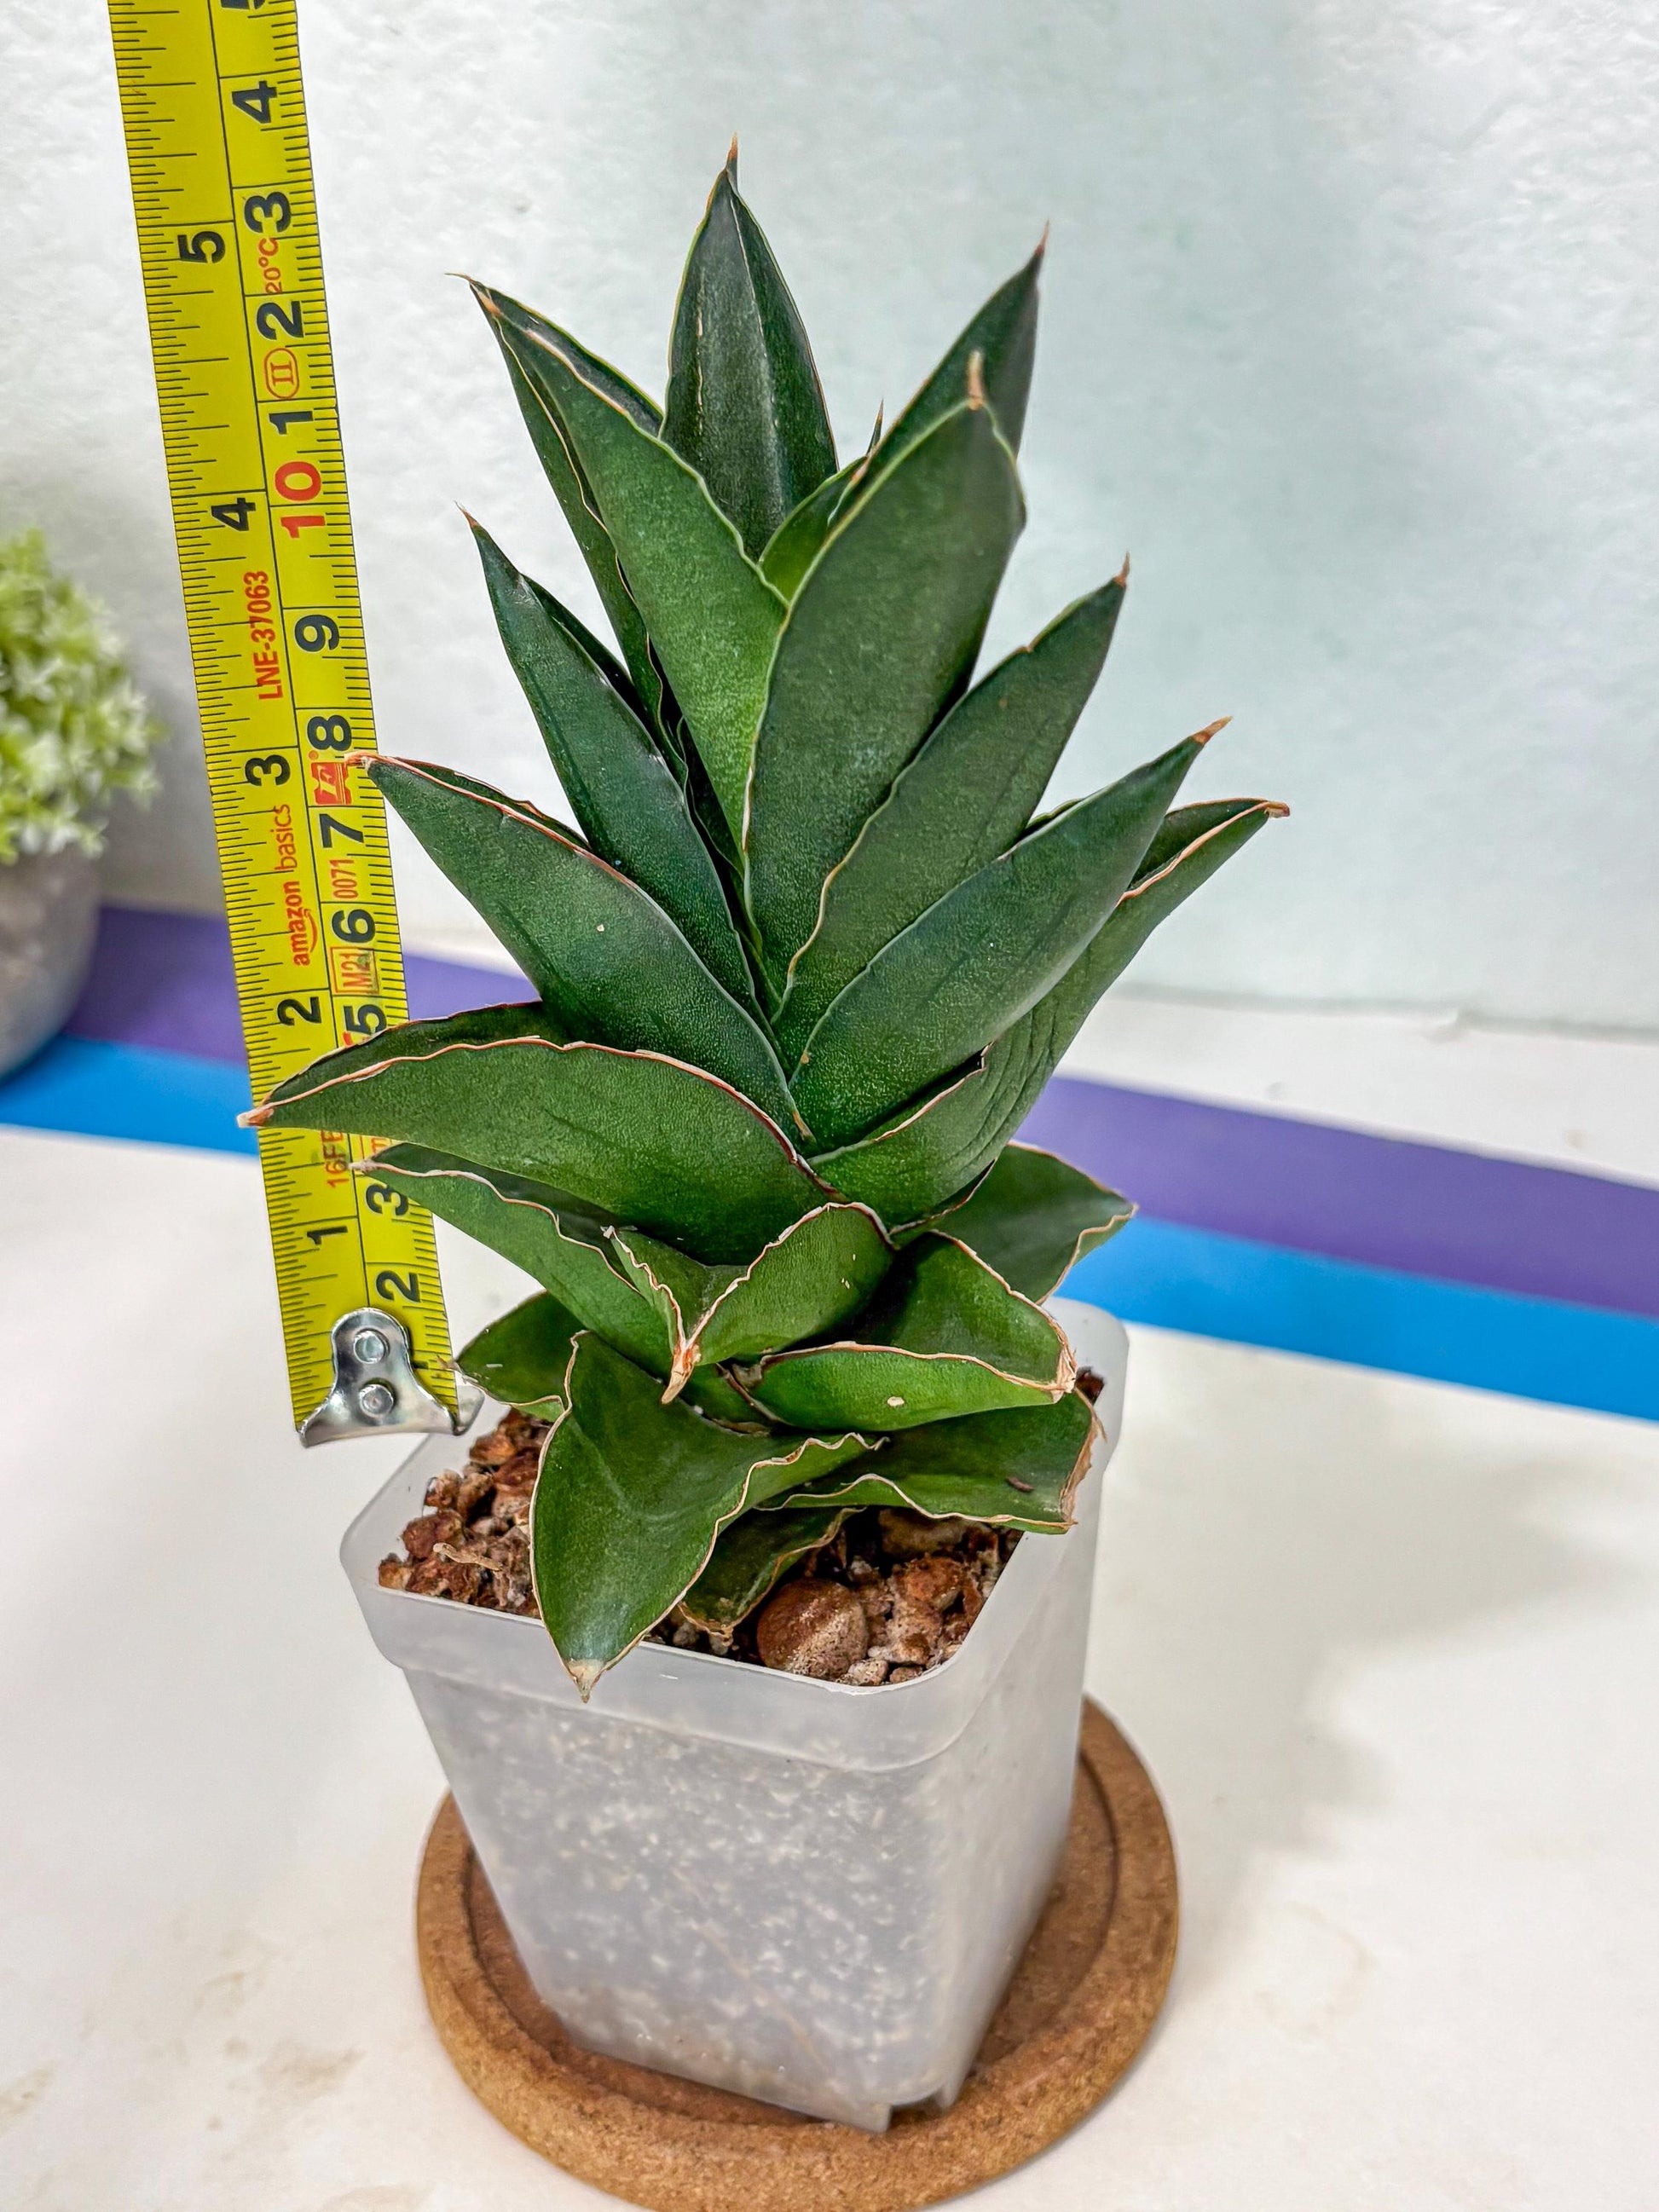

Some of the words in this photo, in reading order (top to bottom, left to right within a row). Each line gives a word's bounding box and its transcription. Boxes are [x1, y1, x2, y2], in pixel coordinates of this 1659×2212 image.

[232, 80, 277, 124] 4
[244, 191, 291, 233] 3
[177, 231, 226, 264] 5
[258, 238, 282, 294] 20°C
[256, 301, 304, 340] 2
[269, 411, 313, 435] 1
[211, 497, 256, 531] 4
[275, 461, 326, 538] 10
[244, 571, 283, 700] LNE-37063
[294, 615, 340, 651] 9
[308, 714, 352, 750] 8
[245, 754, 290, 786] 3
[271, 804, 298, 873] basics
[320, 813, 364, 848] 7
[329, 859, 358, 899] 0071
[283, 881, 309, 967] amazon
[332, 909, 376, 943] 6
[338, 953, 373, 988] M21
[277, 996, 321, 1026] 2
[343, 1004, 386, 1035] 5
[366, 1184, 408, 1216] 3
[307, 1225, 348, 1247] 1
[376, 1270, 419, 1303] 2
